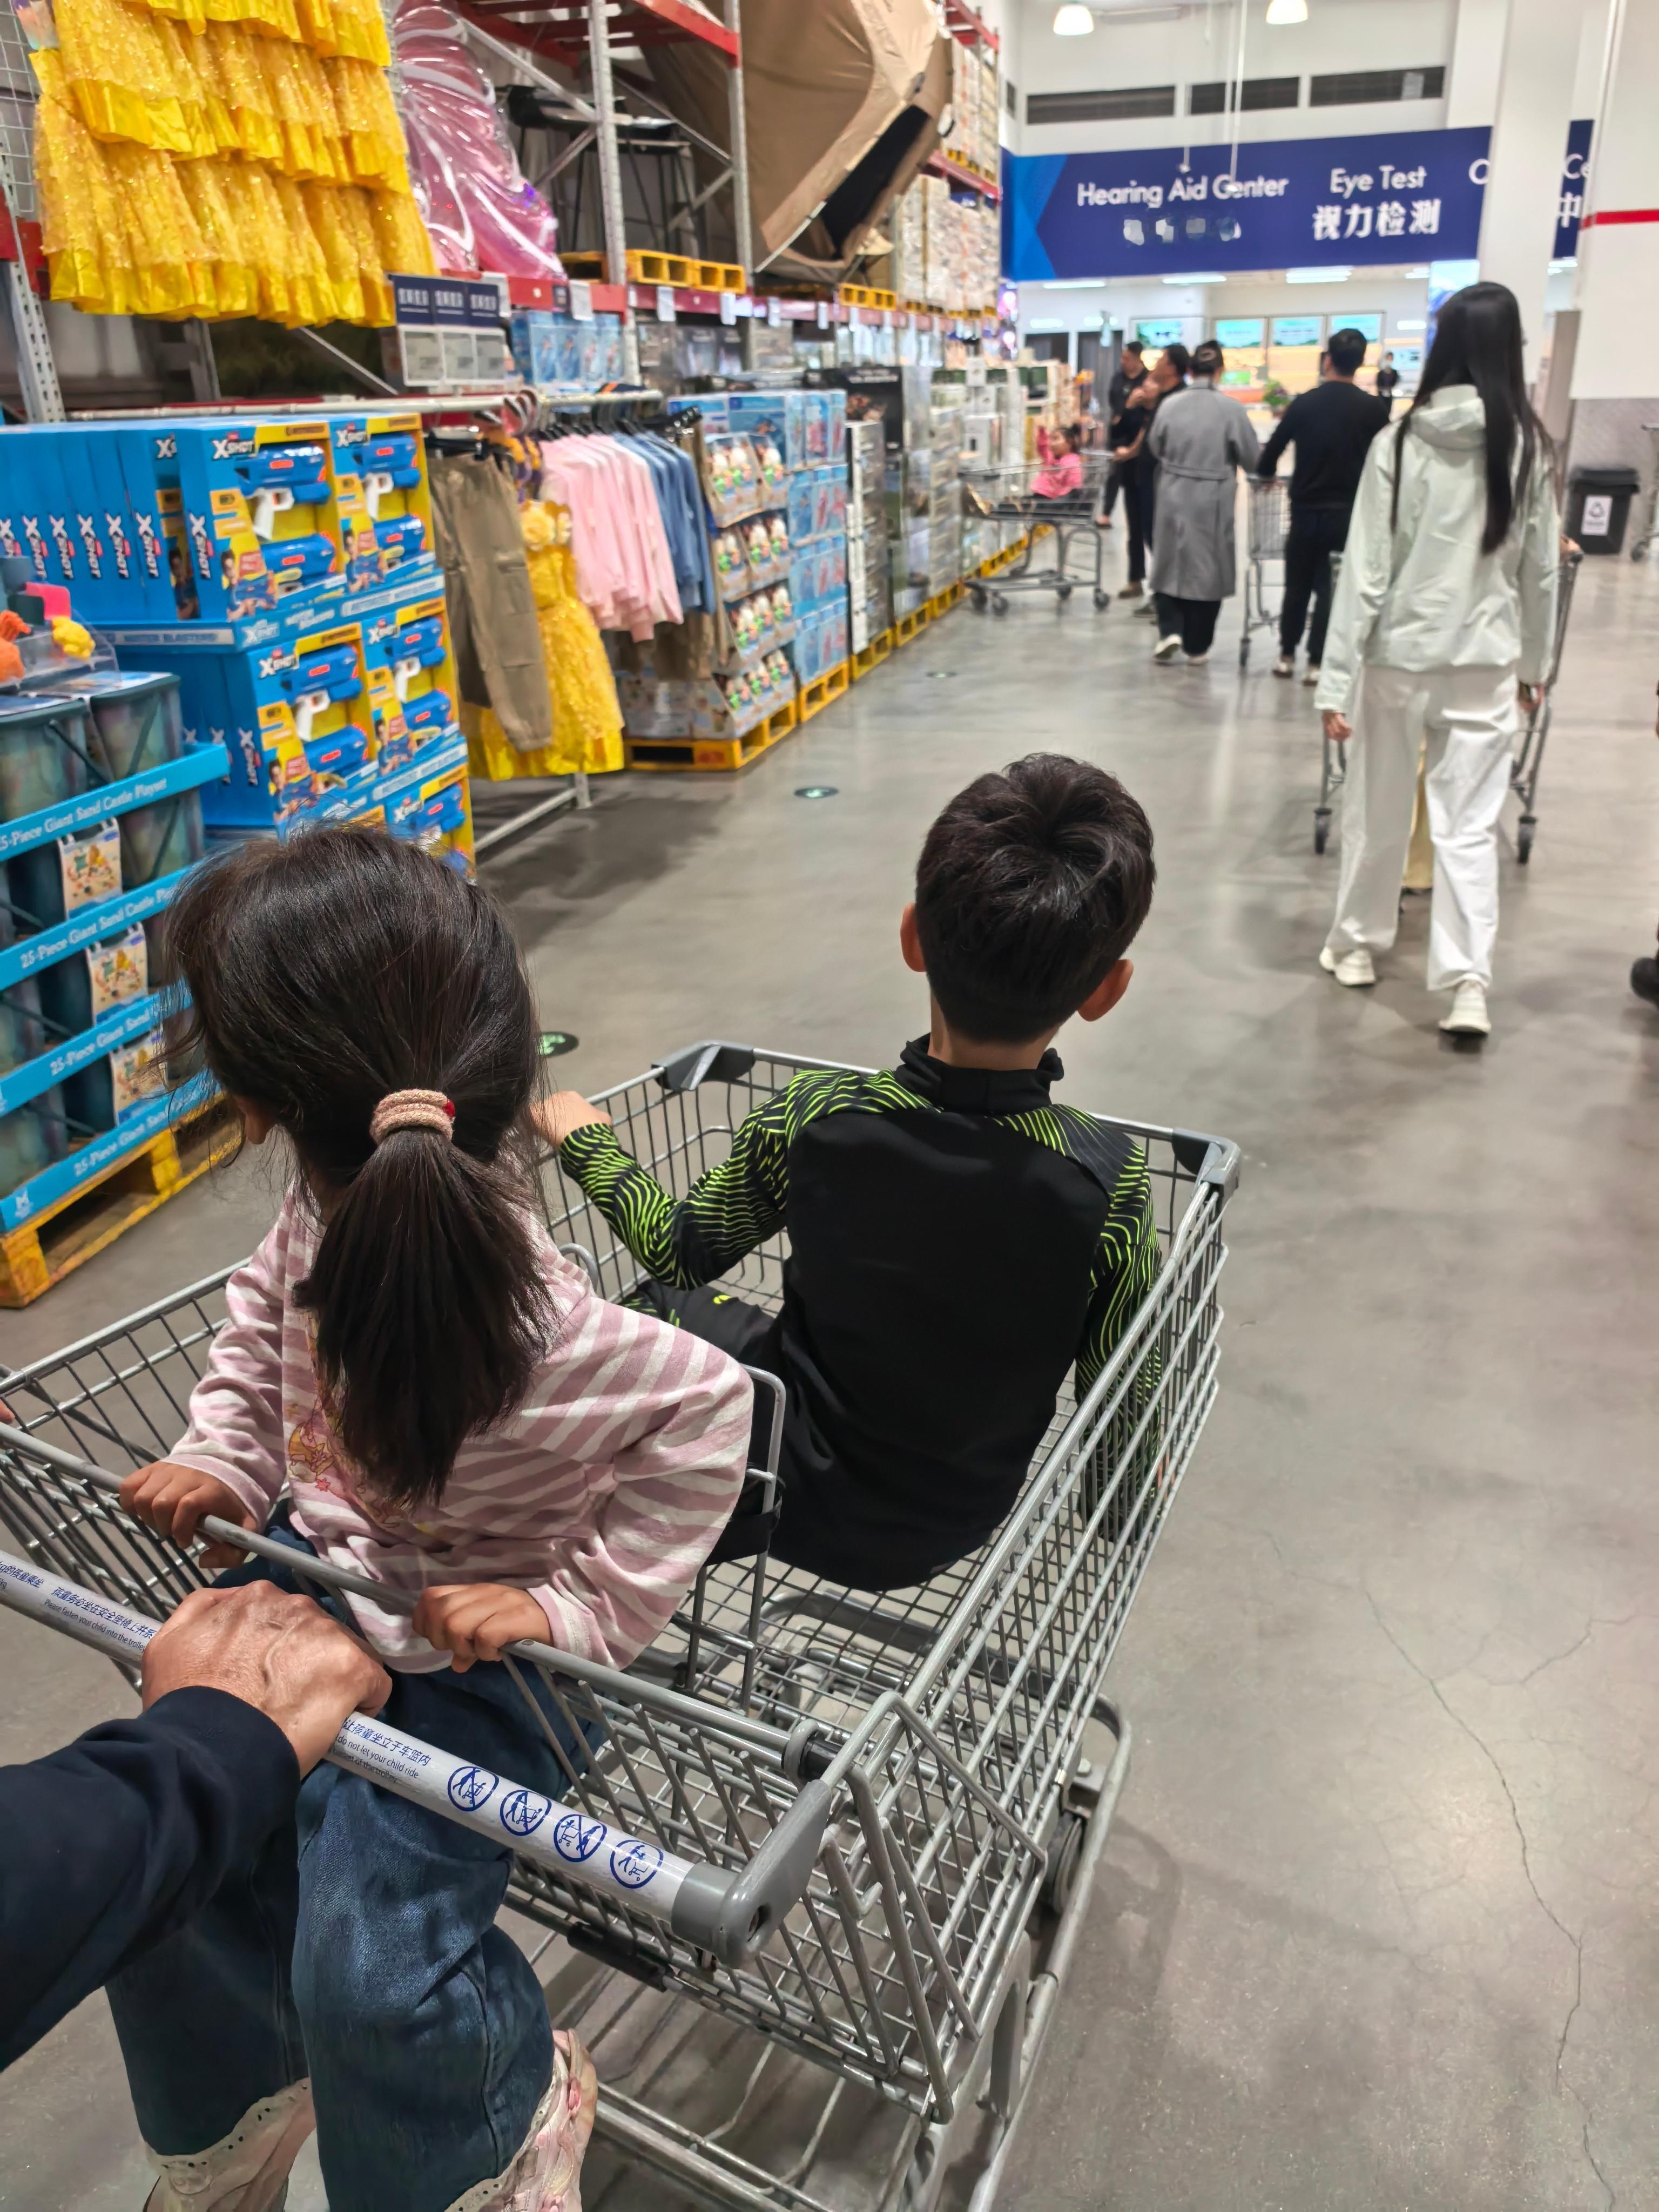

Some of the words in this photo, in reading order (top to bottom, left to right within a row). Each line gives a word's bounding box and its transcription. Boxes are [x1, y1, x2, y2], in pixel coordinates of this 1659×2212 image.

[1077, 180, 1163, 208] Hearing
[1168, 176, 1208, 201] Aid
[1212, 174, 1290, 199] Center
[1330, 167, 1374, 199] Eye
[1379, 164, 1427, 190] Test
[44, 814, 73, 832] Giant
[76, 800, 100, 820] Sand
[104, 791, 132, 810] Castle
[20, 939, 67, 969] 25-Piece
[69, 923, 97, 944] Giant
[99, 909, 124, 930] Sand
[125, 896, 154, 916] Castle
[50, 1043, 96, 1075] 25-Piece
[97, 1027, 124, 1048] Giant
[125, 1009, 150, 1031] Sand
[73, 1144, 117, 1177] 25-Piece
[44, 1598, 62, 1612] Please
[62, 1606, 78, 1620] fasten
[78, 1615, 92, 1627] your
[92, 1621, 106, 1633] child
[106, 1627, 118, 1638] into
[118, 1632, 128, 1643] the
[338, 1735, 347, 1745] do
[348, 1741, 360, 1751] not
[362, 1745, 370, 1756] let
[370, 1751, 387, 1763] your
[387, 1758, 404, 1772] child
[404, 1766, 419, 1779] ride
[342, 1719, 431, 1766] 让孩童坐立于车篮内
